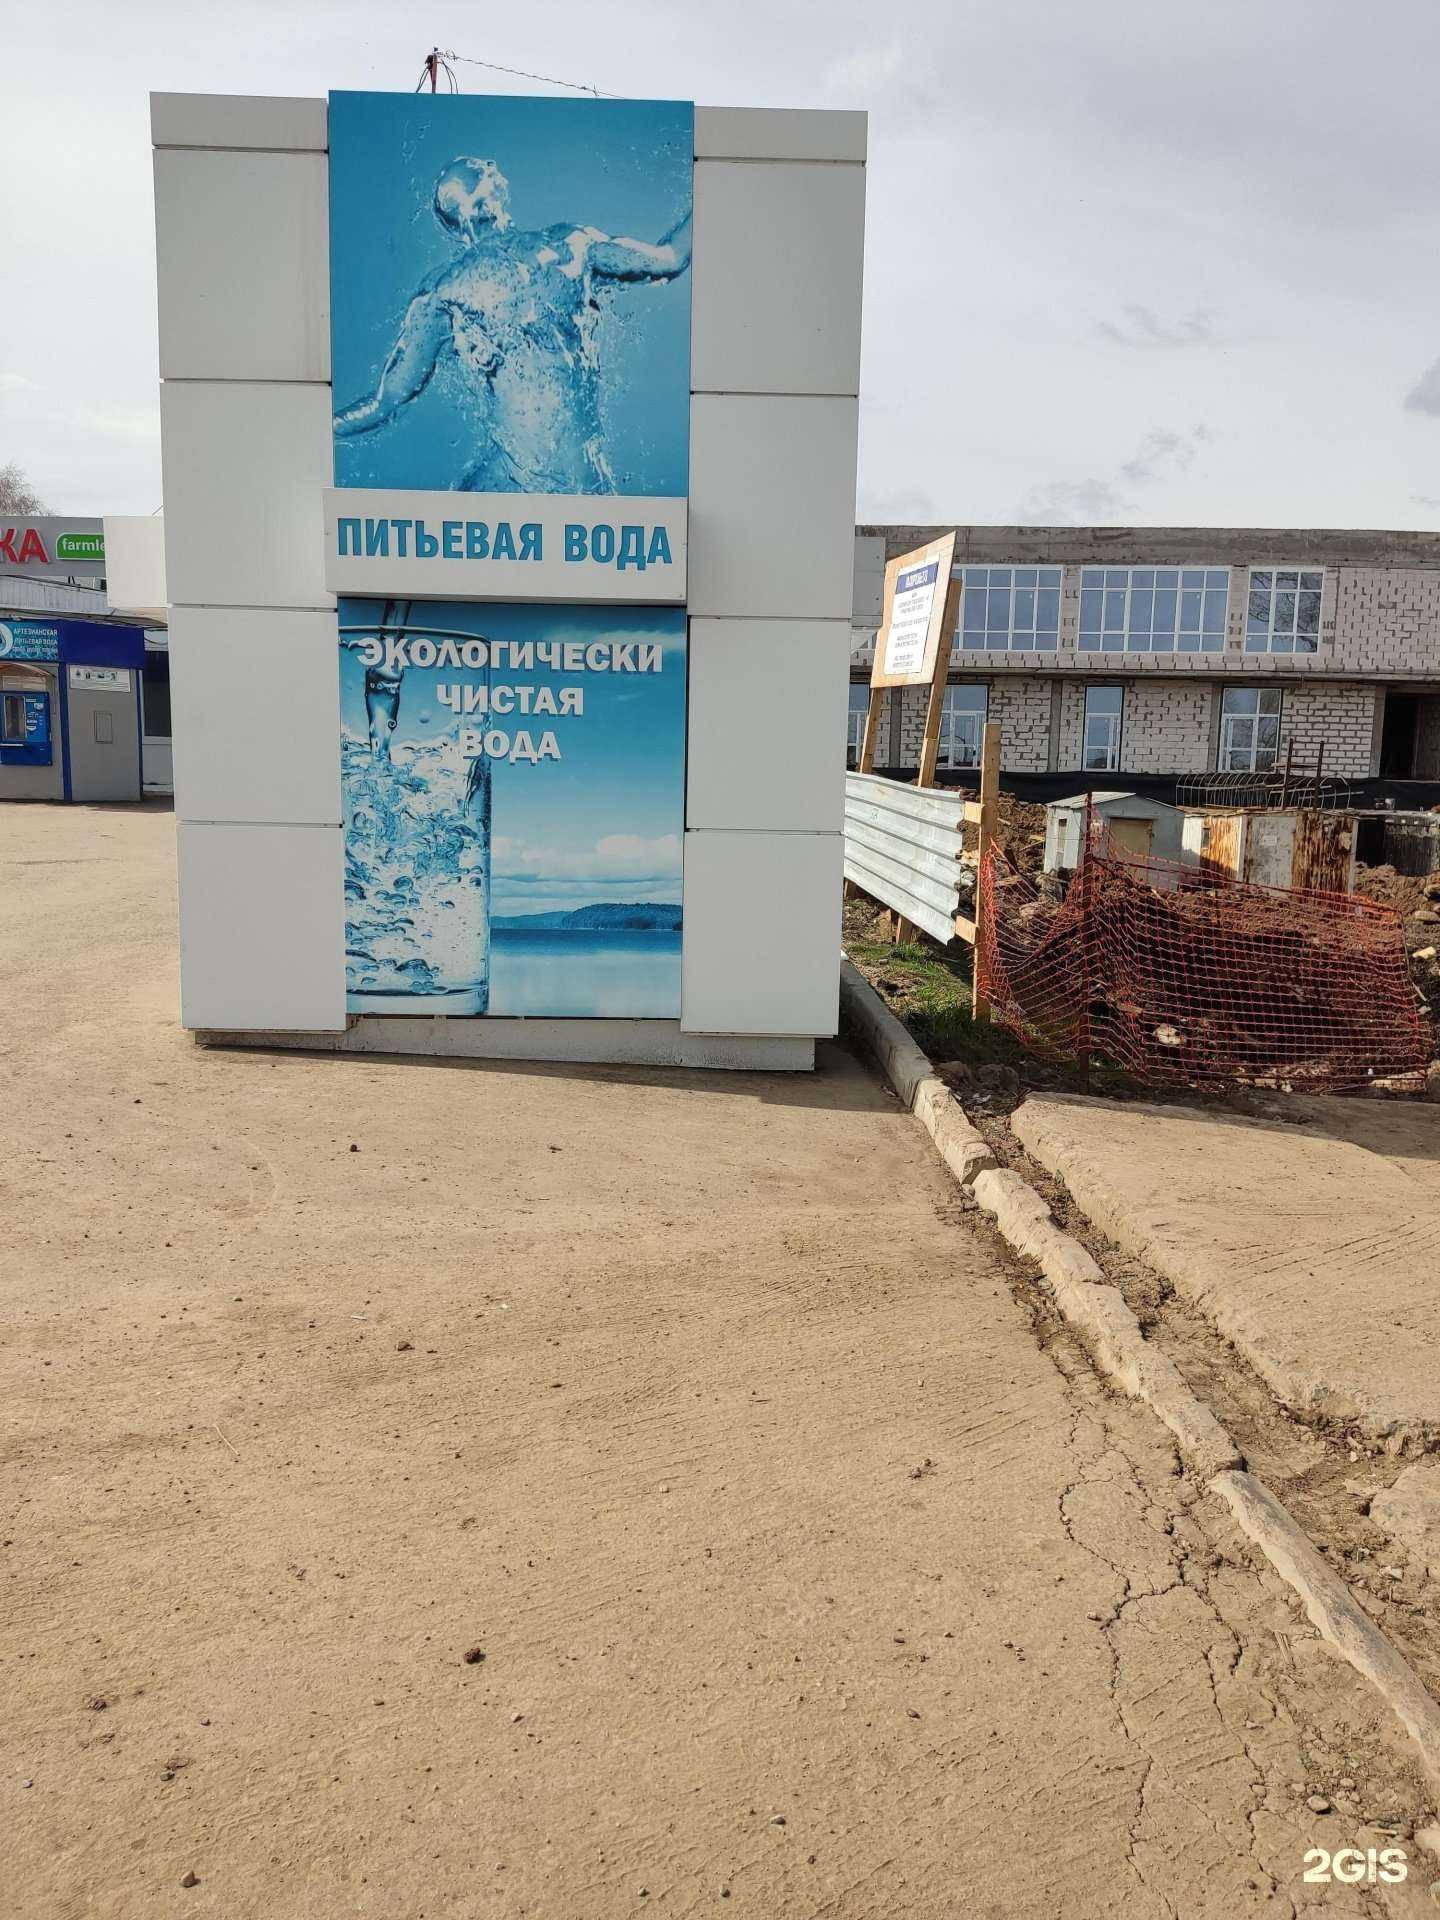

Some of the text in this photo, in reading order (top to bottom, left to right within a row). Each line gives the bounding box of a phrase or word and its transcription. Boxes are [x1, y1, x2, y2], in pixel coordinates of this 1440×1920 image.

[336, 517, 673, 571] ПИТЬЕВАЯ ВОДА
[356, 637, 664, 673] ЭКОЛОГИЧЕСКИ
[436, 683, 584, 716] ЧИСТАЯ
[461, 729, 562, 764] ВОДА
